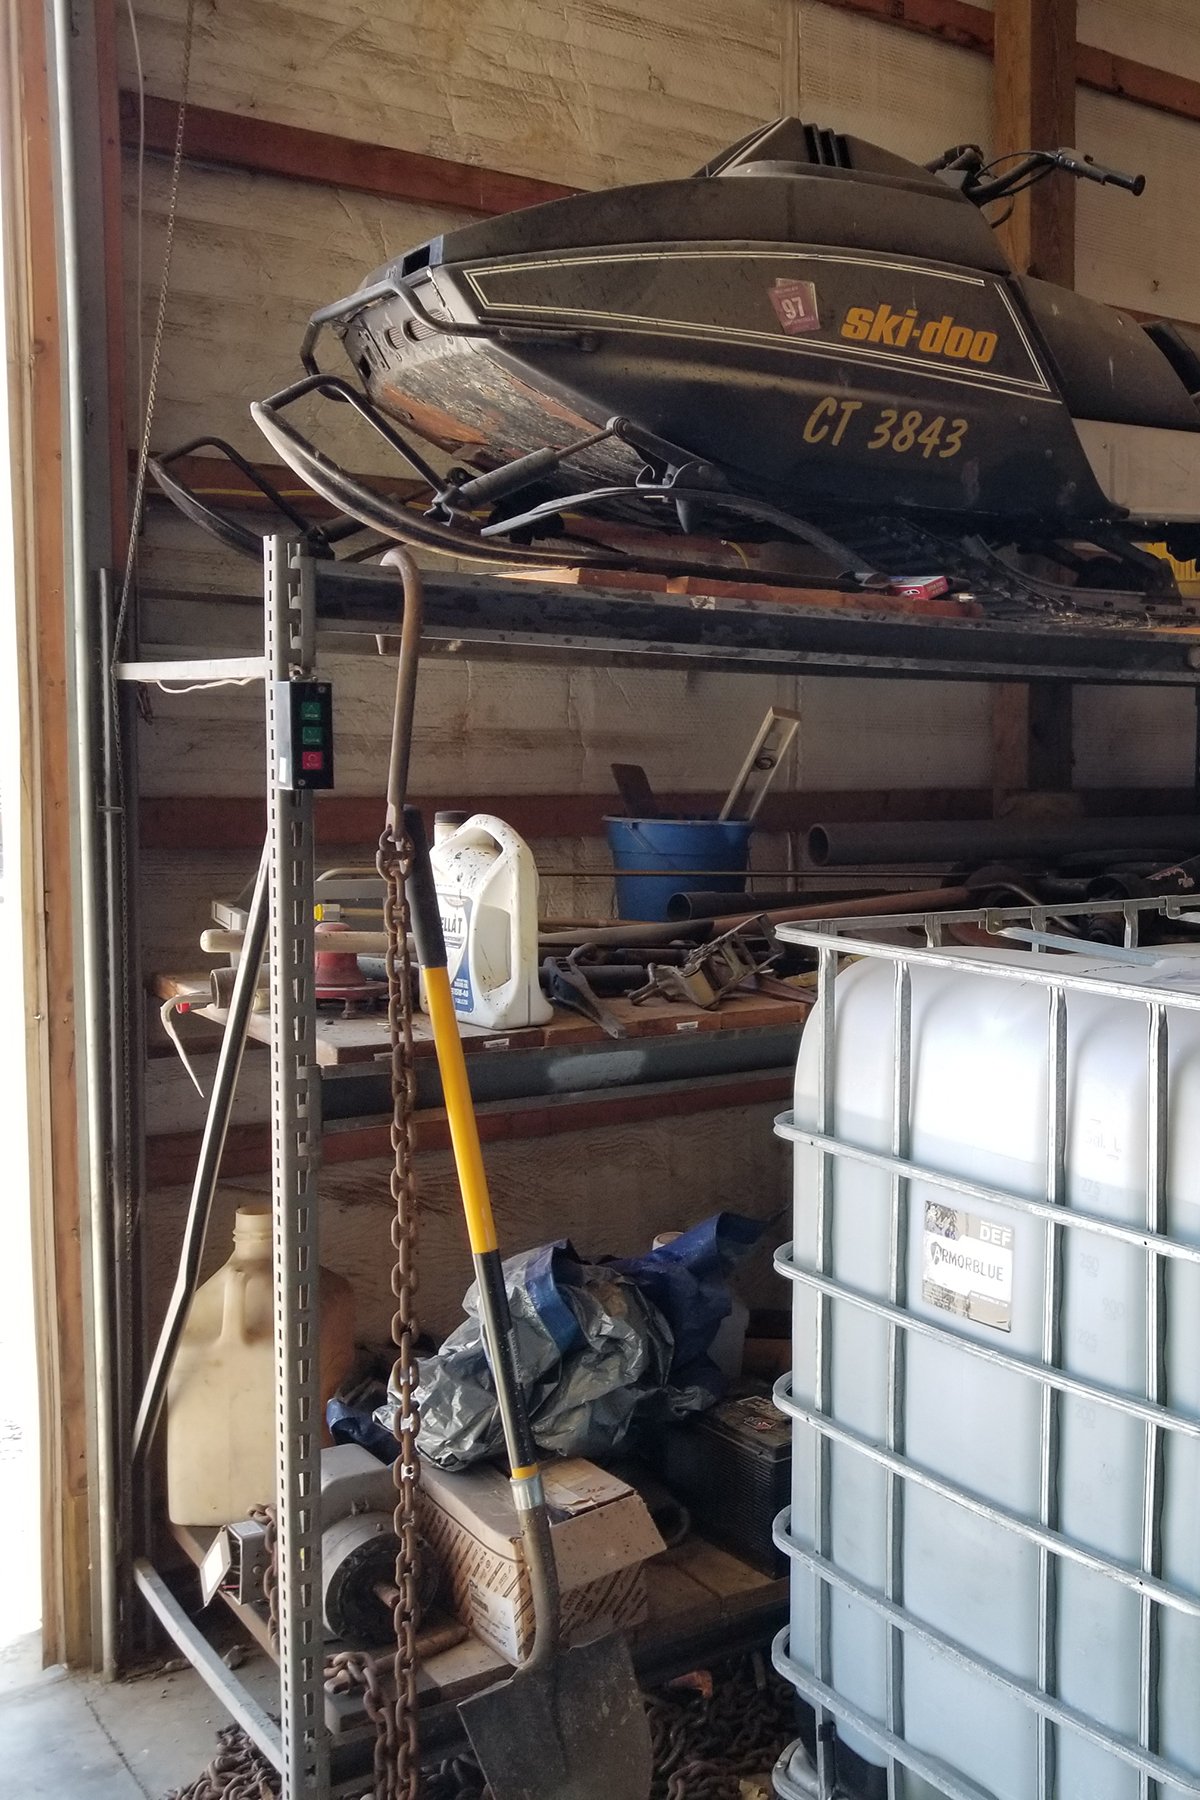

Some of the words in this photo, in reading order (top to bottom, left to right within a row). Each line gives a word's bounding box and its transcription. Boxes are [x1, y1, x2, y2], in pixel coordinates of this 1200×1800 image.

[781, 297, 805, 320] 97
[840, 303, 998, 364] ski-doo
[803, 397, 862, 446] CT
[867, 409, 969, 459] 3843
[980, 1224, 1012, 1246] DEF
[931, 1242, 1004, 1282] ARMORBLUE
